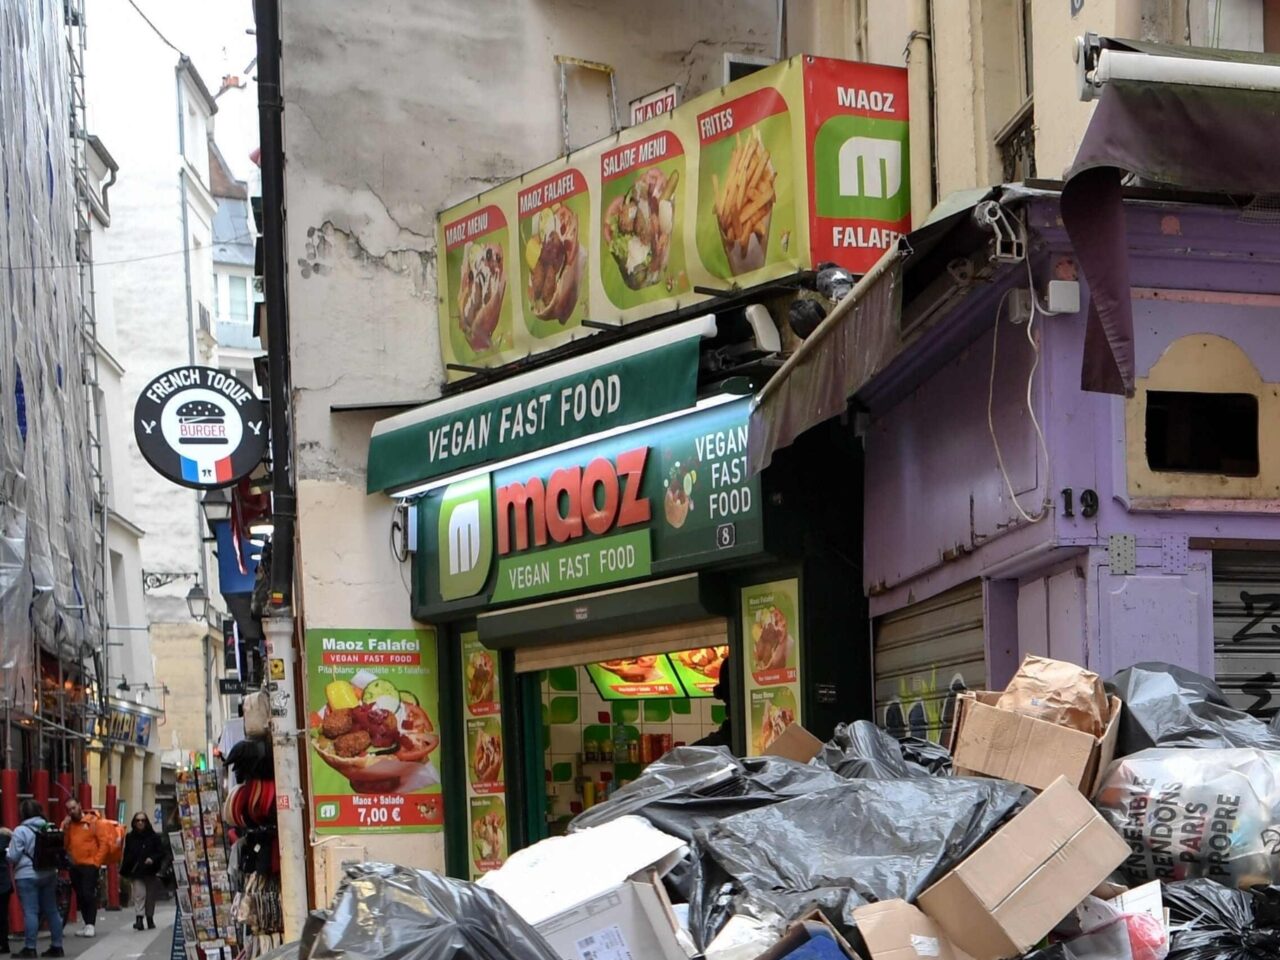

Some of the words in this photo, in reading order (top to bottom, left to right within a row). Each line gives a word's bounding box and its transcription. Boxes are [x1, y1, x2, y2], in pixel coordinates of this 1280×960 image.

[837, 86, 895, 113] MAOZ
[700, 108, 733, 139] FRITES
[603, 150, 635, 177] SALADE
[638, 136, 667, 163] MENU
[520, 187, 542, 213] MAOZ
[543, 175, 575, 203] FALAFEL
[445, 224, 466, 243] MAOZ
[467, 212, 488, 236] MENU
[146, 368, 200, 404] FRENCH
[206, 370, 252, 406] TOQUE
[180, 424, 226, 437] BURGER
[428, 412, 491, 463] VEGAN
[499, 393, 551, 443] FAST
[560, 374, 621, 426] FOOD
[695, 425, 748, 462] VEGAN
[711, 456, 748, 489] FAST
[496, 446, 651, 555] maoz
[709, 486, 751, 519] FOOD
[1060, 488, 1099, 518] 19
[721, 527, 730, 545] 8
[508, 561, 550, 590] VEGAN
[559, 553, 590, 581] FAST
[600, 544, 635, 573] FOOD
[322, 638, 364, 650] Maoz
[368, 638, 420, 651] Falafel
[330, 654, 359, 663] VEGAN
[364, 654, 384, 662] FAST
[390, 654, 412, 663] FOOD
[357, 807, 388, 825] 7,00
[391, 807, 401, 822] €
[1150, 782, 1183, 879] RENDONS
[1179, 802, 1209, 863] PARIS
[1208, 794, 1241, 877] PROPRE
